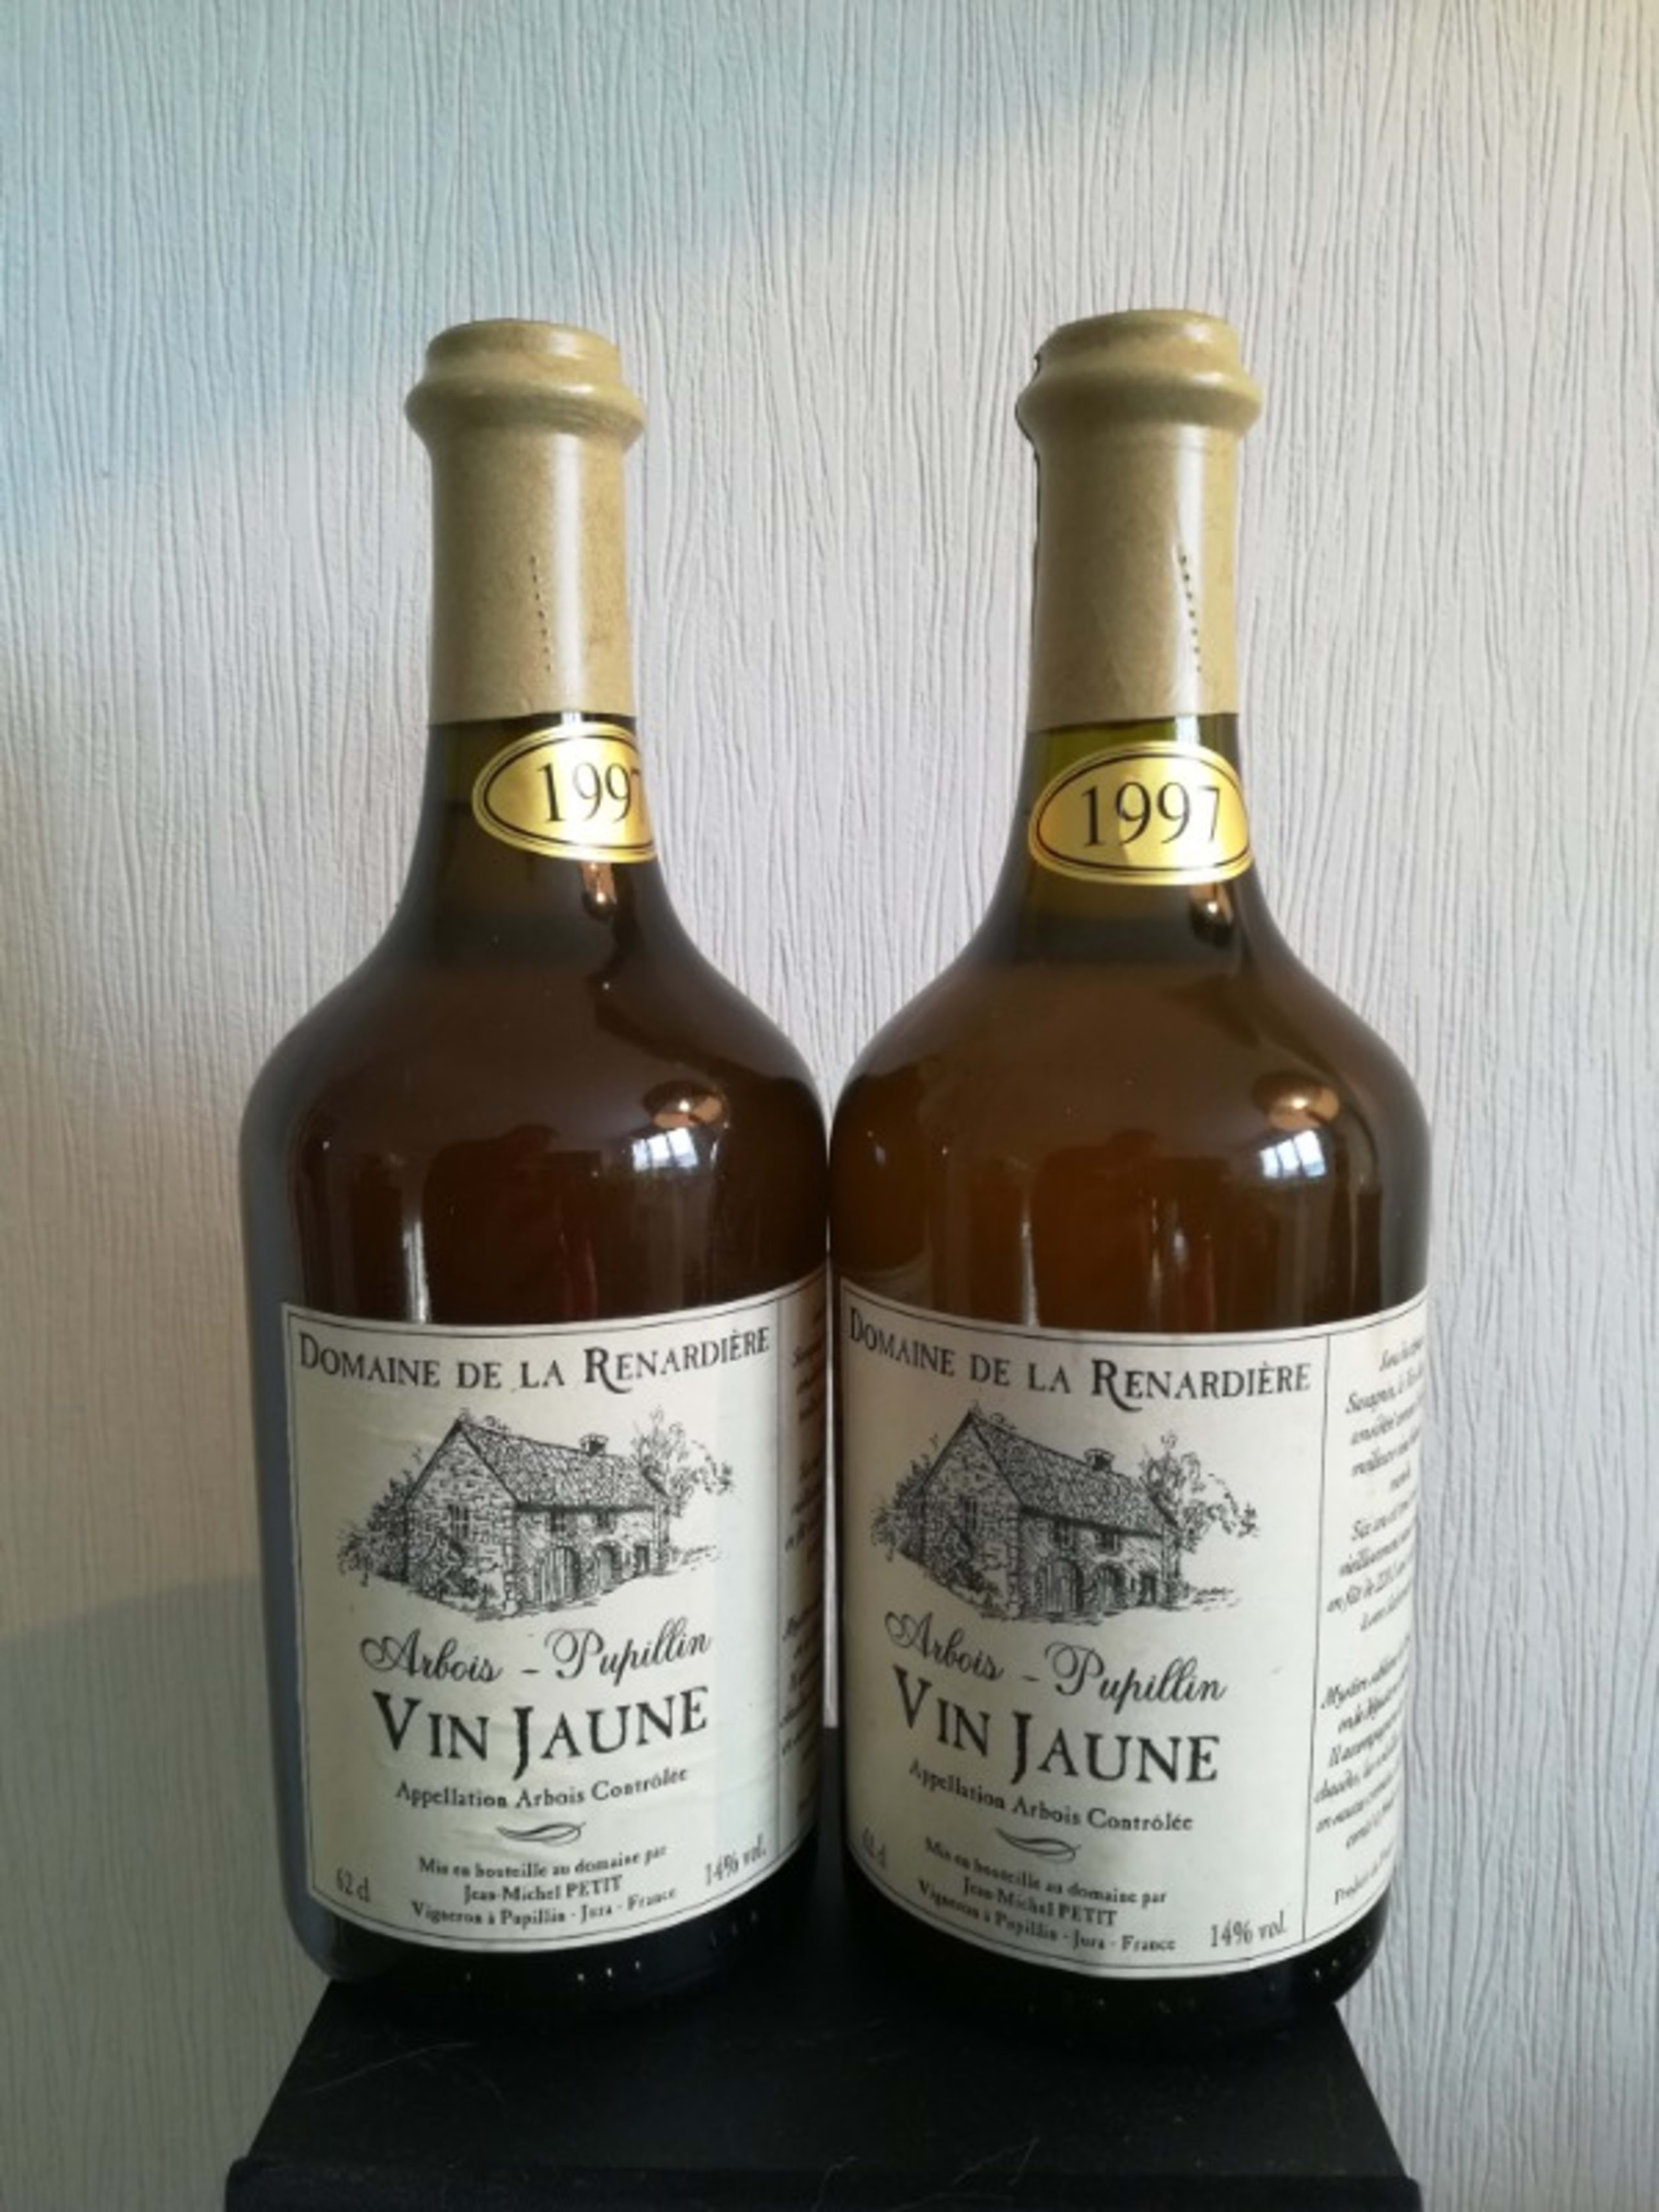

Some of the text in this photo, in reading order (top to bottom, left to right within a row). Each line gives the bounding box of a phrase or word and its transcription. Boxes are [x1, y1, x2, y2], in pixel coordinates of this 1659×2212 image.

[1081, 780, 1222, 848] 1997
[299, 1332, 441, 1388] DOMAINE
[457, 1363, 501, 1389] DE
[520, 1360, 564, 1388] LA
[585, 1326, 770, 1393] RENARDIÈRE
[849, 1306, 955, 1377] DOMAINE
[969, 1353, 1009, 1386] DE
[1028, 1362, 1071, 1394] LA
[1092, 1358, 1310, 1412] RENARDIÈRE
[360, 1627, 502, 1682] Arbois
[544, 1617, 712, 1686] Pupillin
[885, 1611, 1004, 1681] Arbois
[1045, 1642, 1226, 1714] Pupillin
[372, 1690, 489, 1761] VIN
[512, 1686, 708, 1780] JAUNE
[893, 1664, 991, 1757] VIN
[1011, 1711, 1220, 1784] JAUNE
[395, 1780, 507, 1808] Appellation
[515, 1788, 585, 1808] Arbois
[909, 1758, 1006, 1810] Appellation
[1012, 1796, 1082, 1826] Arbois
[566, 1874, 623, 1898] PETIT
[705, 1849, 739, 1886] 14%
[1066, 1881, 1137, 1903] domaine
[1141, 1892, 1166, 1908] par
[1058, 1903, 1117, 1926] PETIT
[1122, 1935, 1176, 1951] France
[1211, 1918, 1253, 1948] 14%
